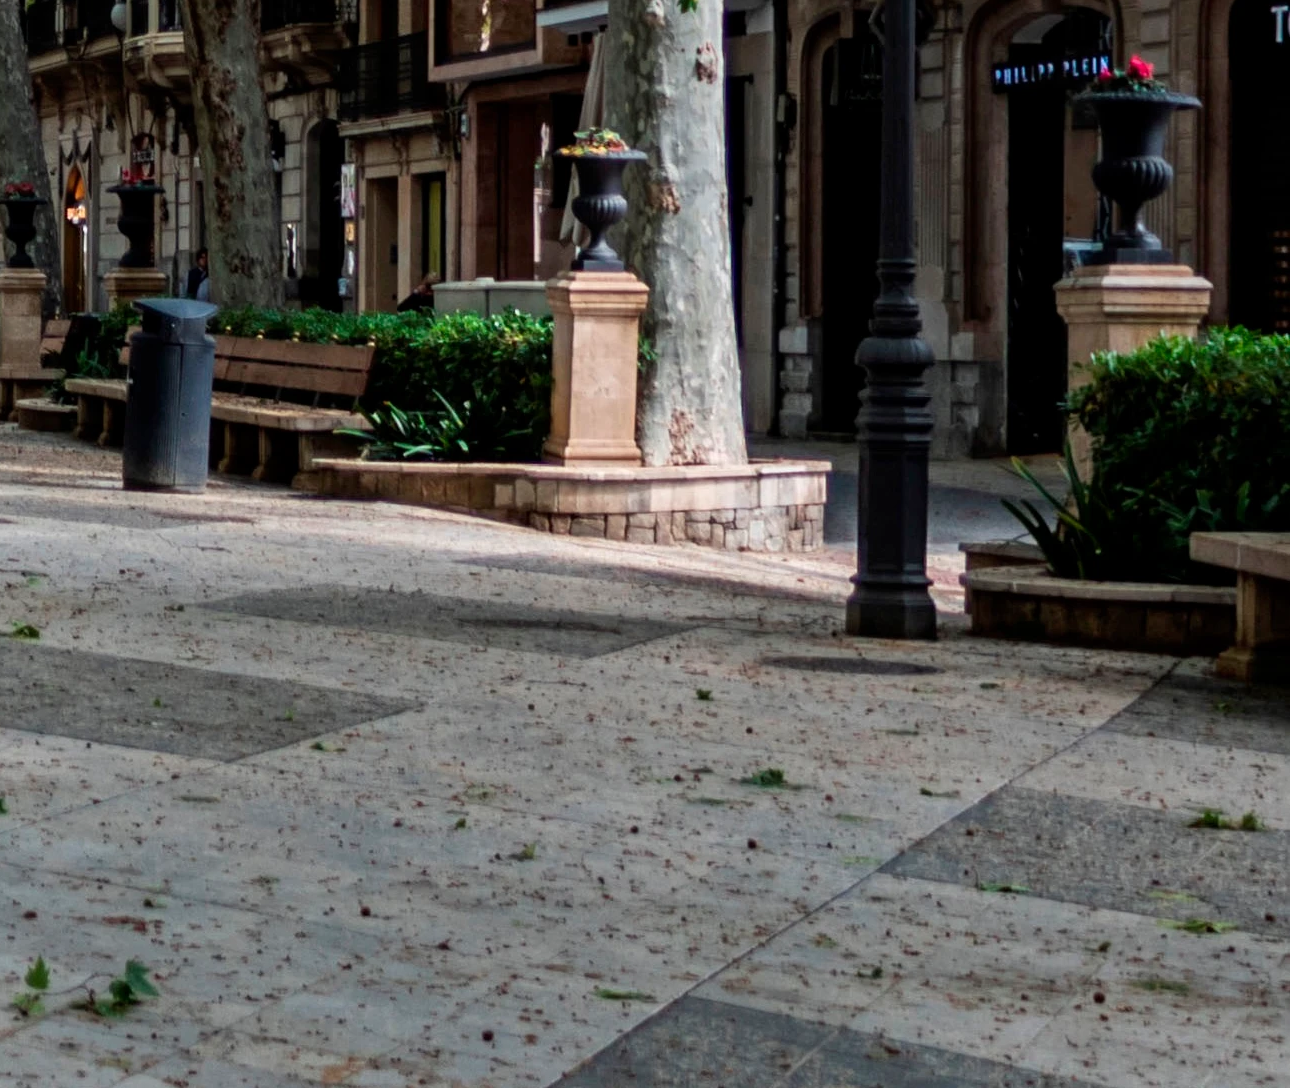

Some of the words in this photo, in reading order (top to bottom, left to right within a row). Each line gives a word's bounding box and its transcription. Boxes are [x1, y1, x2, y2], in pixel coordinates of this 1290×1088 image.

[1270, 4, 1290, 43] T
[995, 63, 1054, 85] PHILIPP
[1063, 56, 1109, 77] PLEIN
